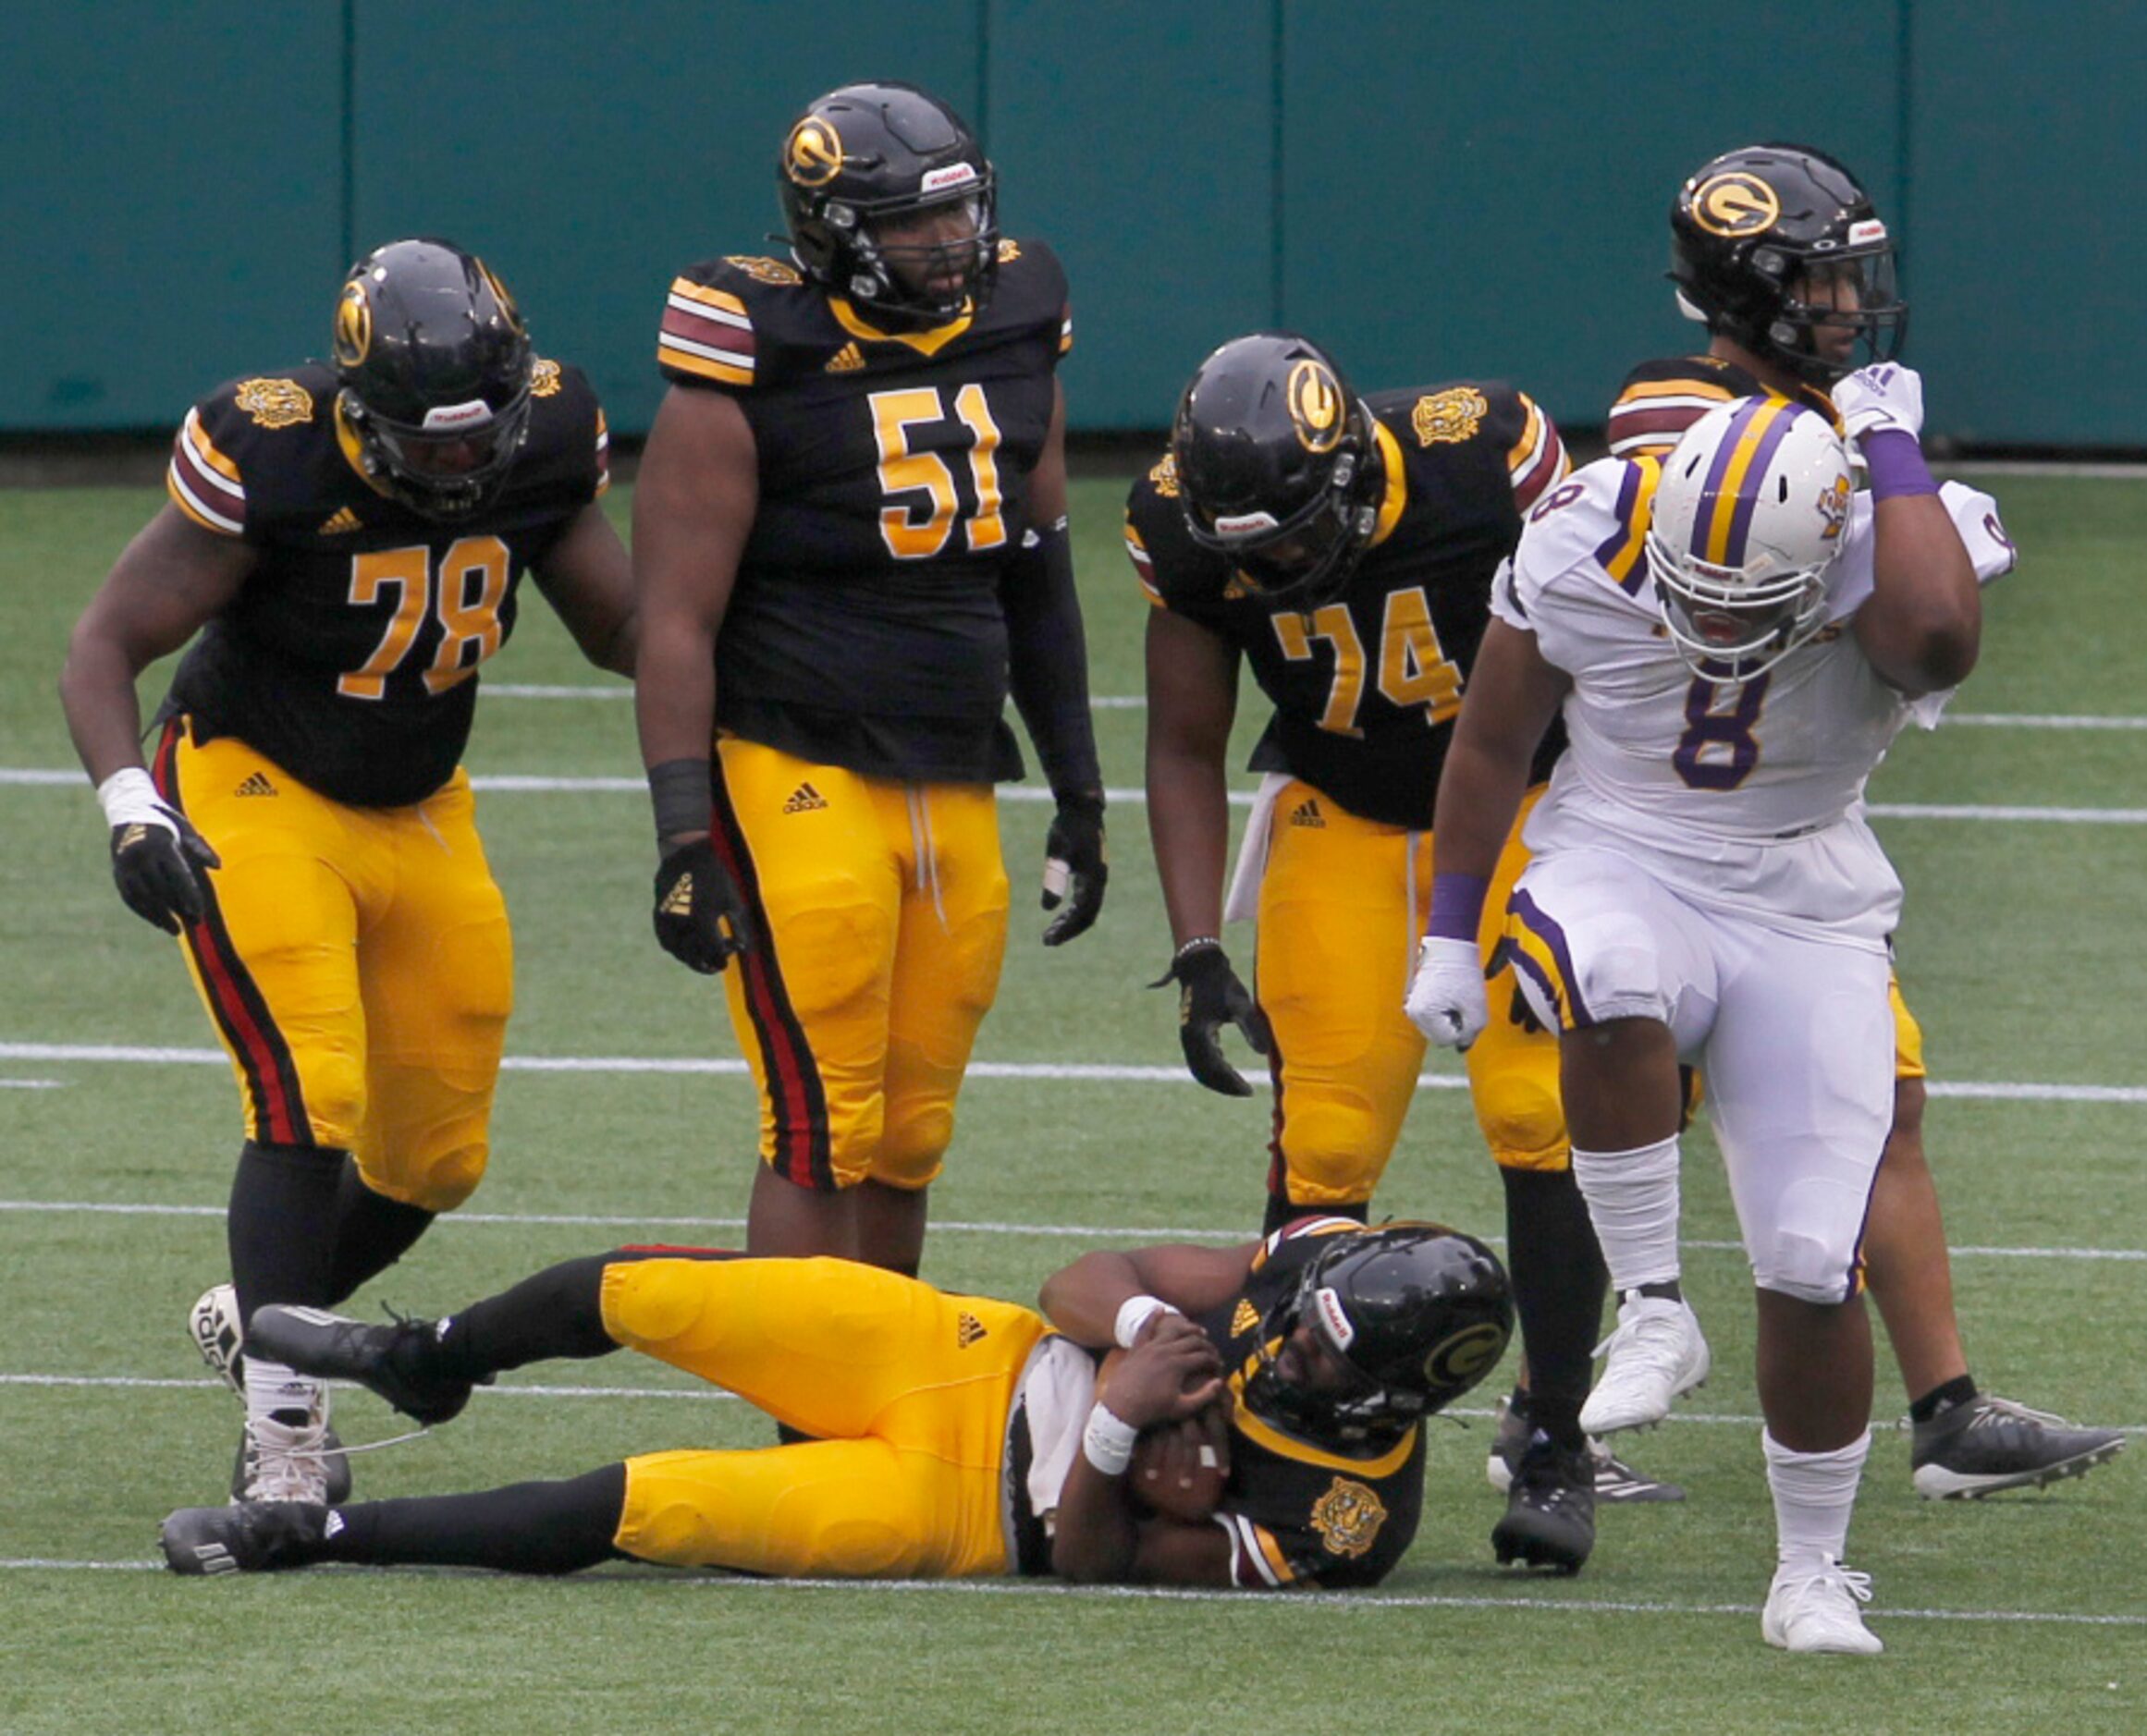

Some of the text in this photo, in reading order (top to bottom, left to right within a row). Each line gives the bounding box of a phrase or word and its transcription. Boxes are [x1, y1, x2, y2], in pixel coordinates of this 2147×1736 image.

[867, 384, 1006, 559] 51
[1530, 483, 1584, 522] 8
[337, 535, 509, 700] 78
[1271, 586, 1464, 739] 74
[1673, 653, 1772, 792] 8
